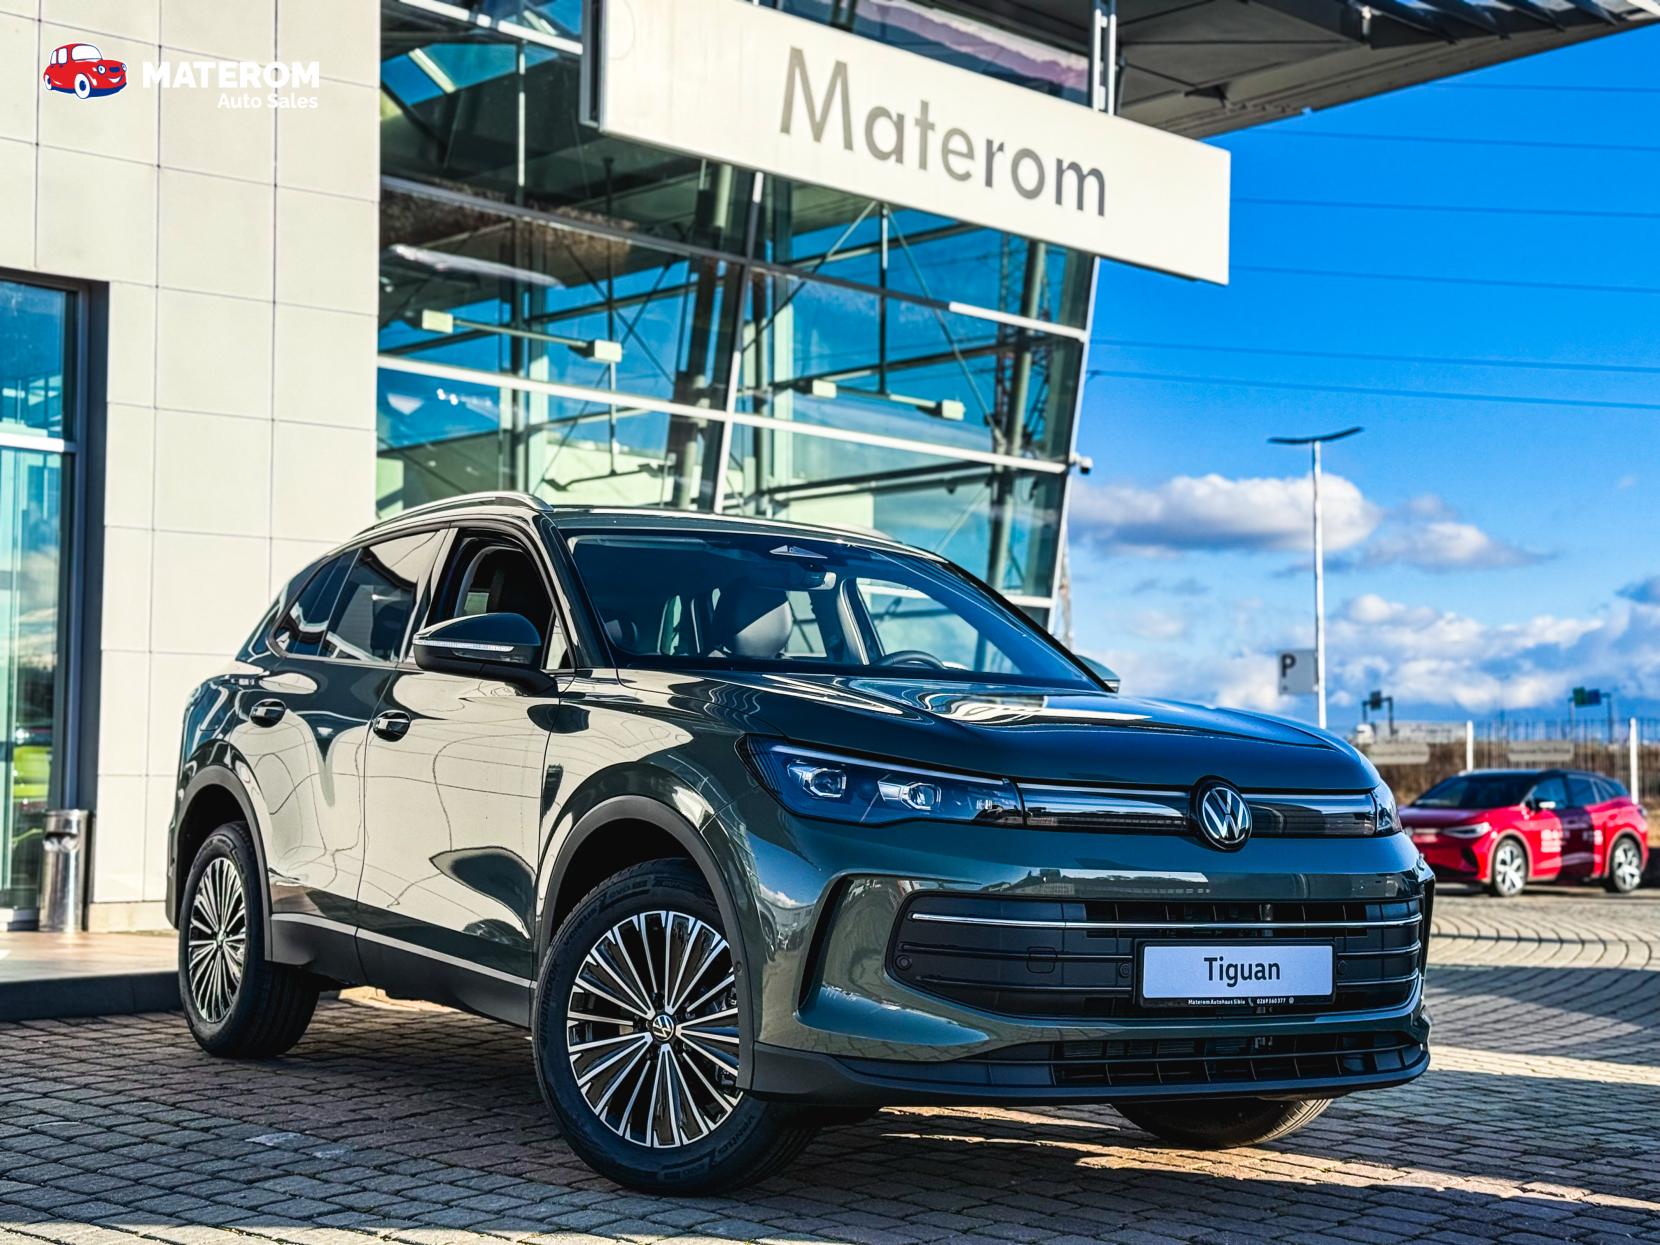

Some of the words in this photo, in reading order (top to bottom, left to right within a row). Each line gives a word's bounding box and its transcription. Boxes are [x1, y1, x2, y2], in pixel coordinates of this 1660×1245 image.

[780, 46, 1105, 217] Materom
[1281, 653, 1297, 679] P
[1203, 955, 1281, 988] Tiguan
